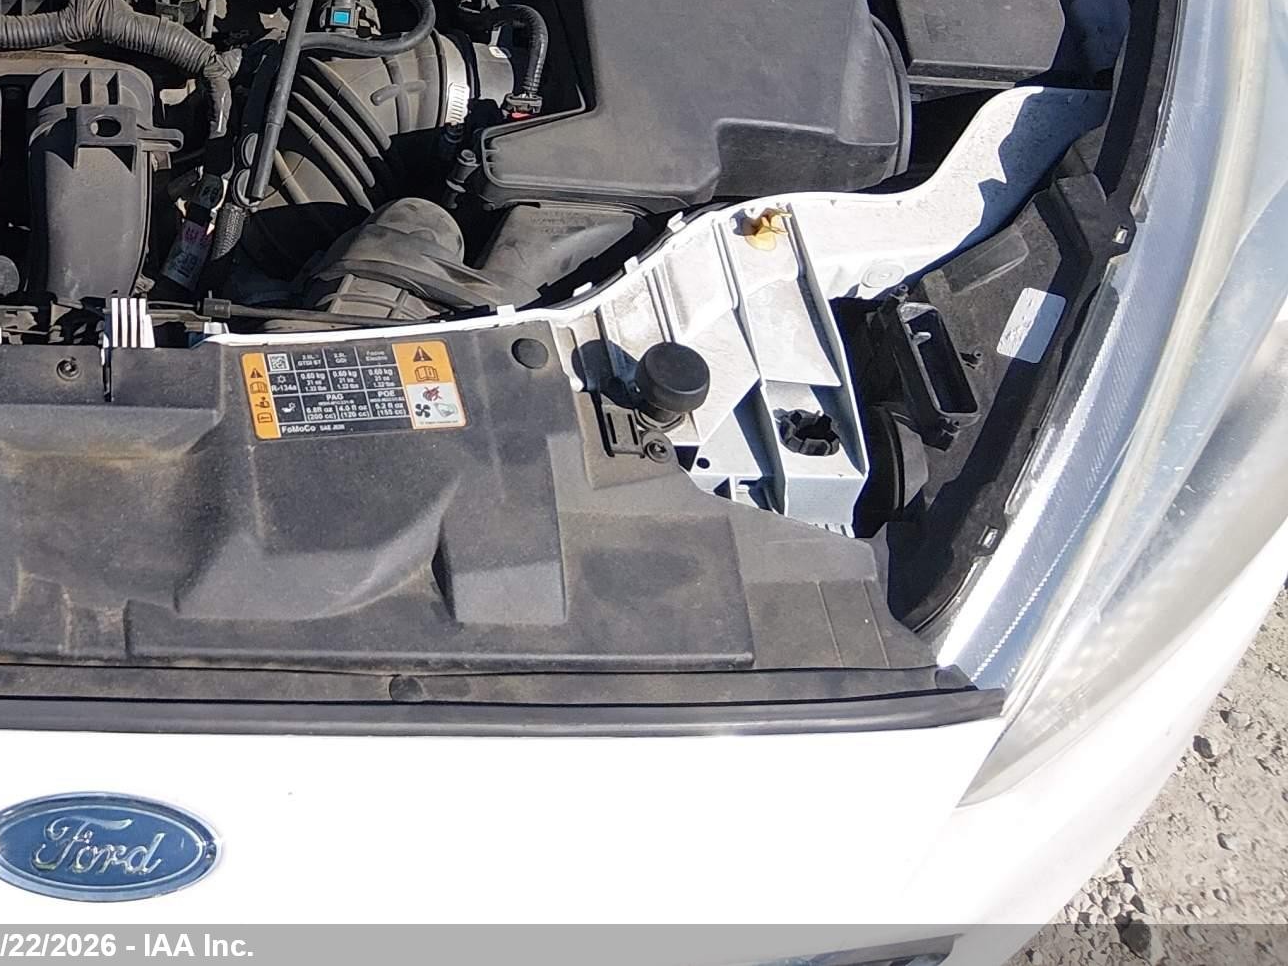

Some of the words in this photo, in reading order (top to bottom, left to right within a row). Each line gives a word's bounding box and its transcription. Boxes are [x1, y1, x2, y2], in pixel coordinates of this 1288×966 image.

[326, 393, 344, 401] PAG
[340, 411, 357, 419] (120
[281, 425, 316, 433] FoMoCo
[32, 815, 166, 875] Ford
